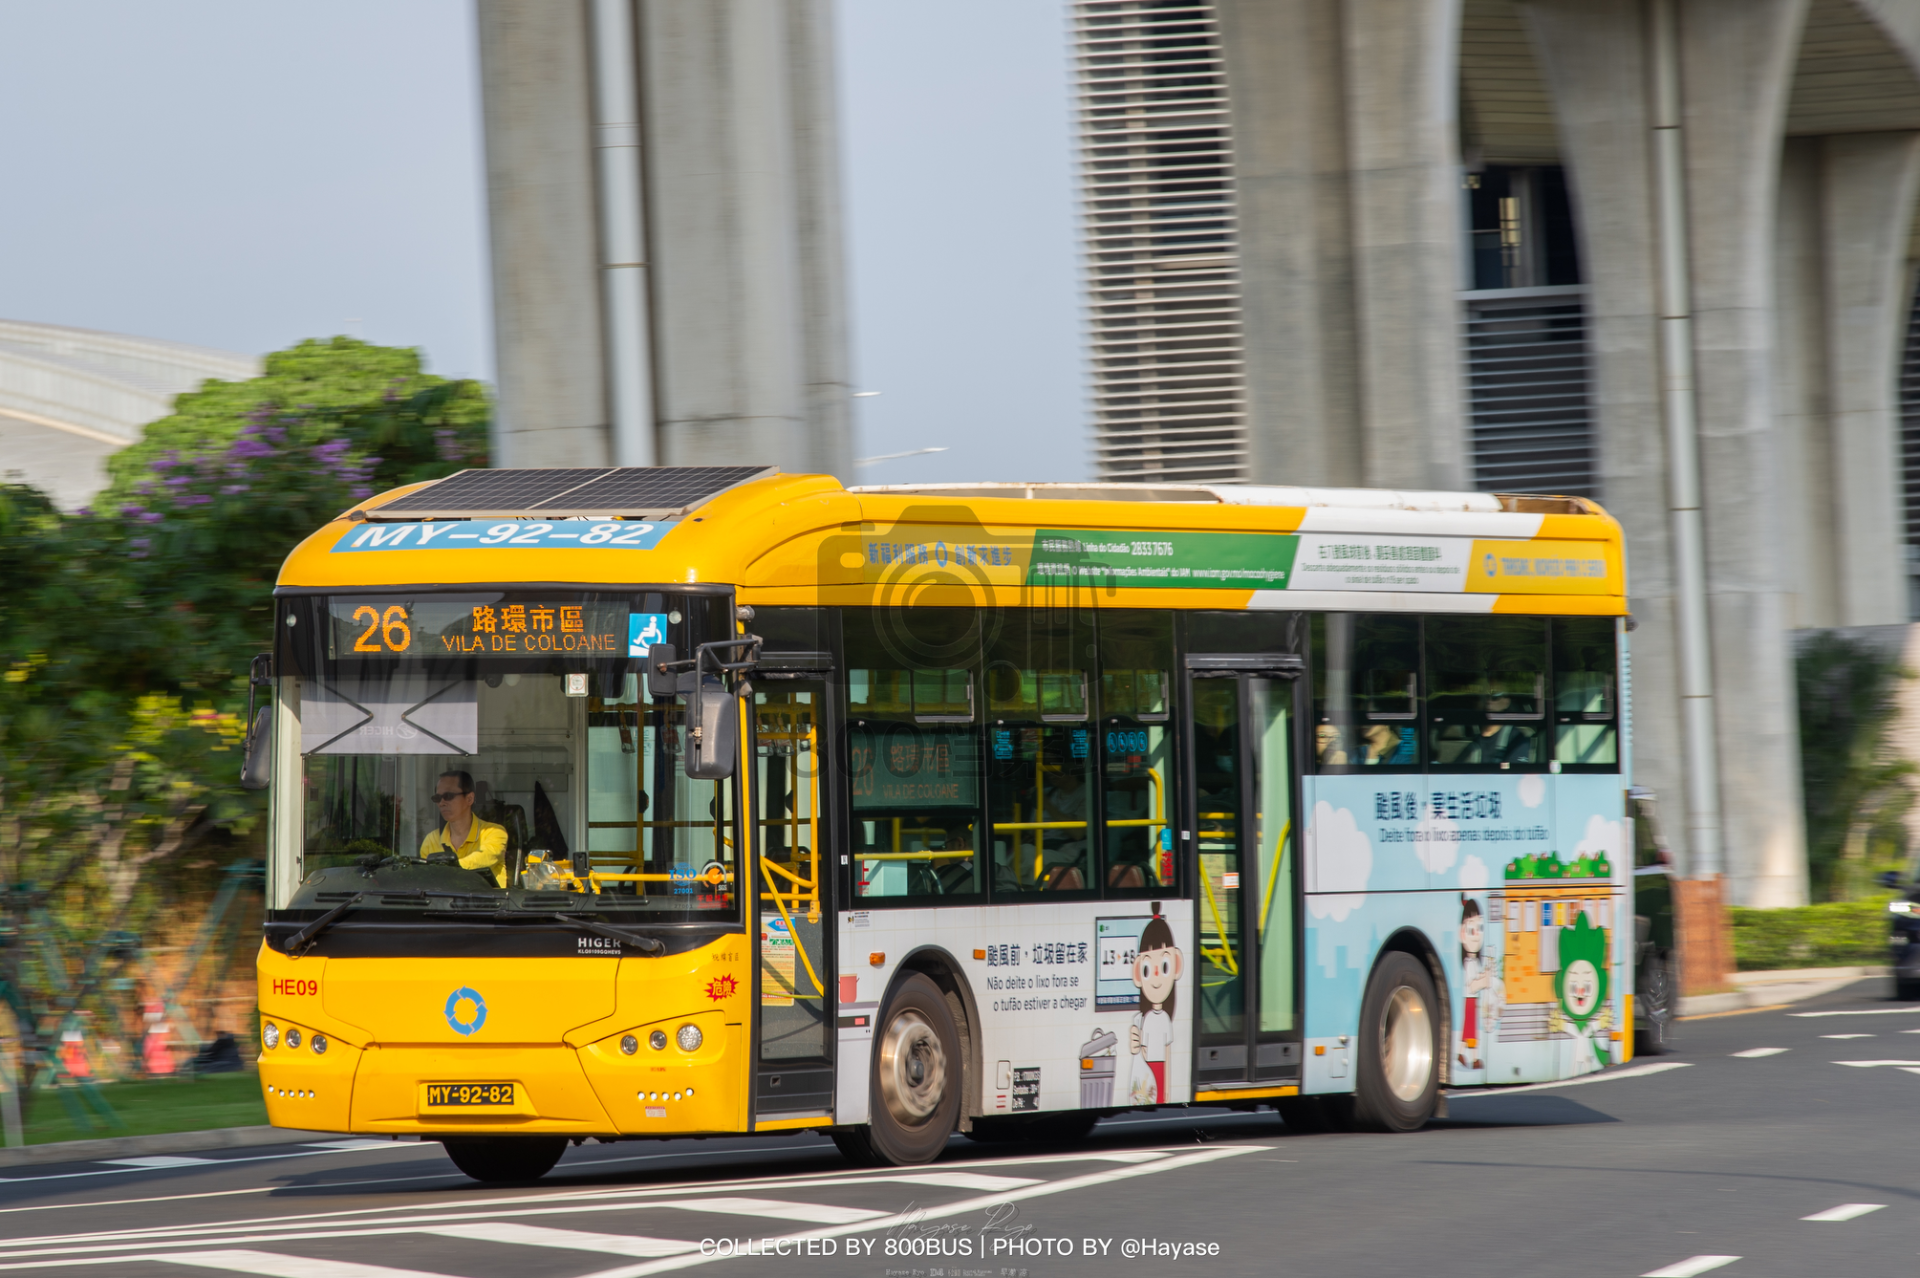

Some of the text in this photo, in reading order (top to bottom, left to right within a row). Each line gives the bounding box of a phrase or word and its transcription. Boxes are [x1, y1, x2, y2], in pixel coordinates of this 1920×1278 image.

[350, 523, 654, 547] MY-92-82
[472, 604, 585, 633] 路環市區
[353, 605, 411, 652] 26
[441, 633, 616, 652] VILA DE COLOANE
[669, 868, 697, 880] ISO
[578, 937, 621, 948] HIGER
[273, 979, 318, 996] HE09
[987, 973, 1079, 990] Não deite o lixo fora se
[993, 1001, 999, 1012] o
[1001, 997, 1022, 1011] tufão
[1024, 996, 1050, 1011] estiver
[1053, 999, 1058, 1009] a
[1060, 995, 1087, 1011] chegar
[429, 1085, 512, 1104] MY-92-82
